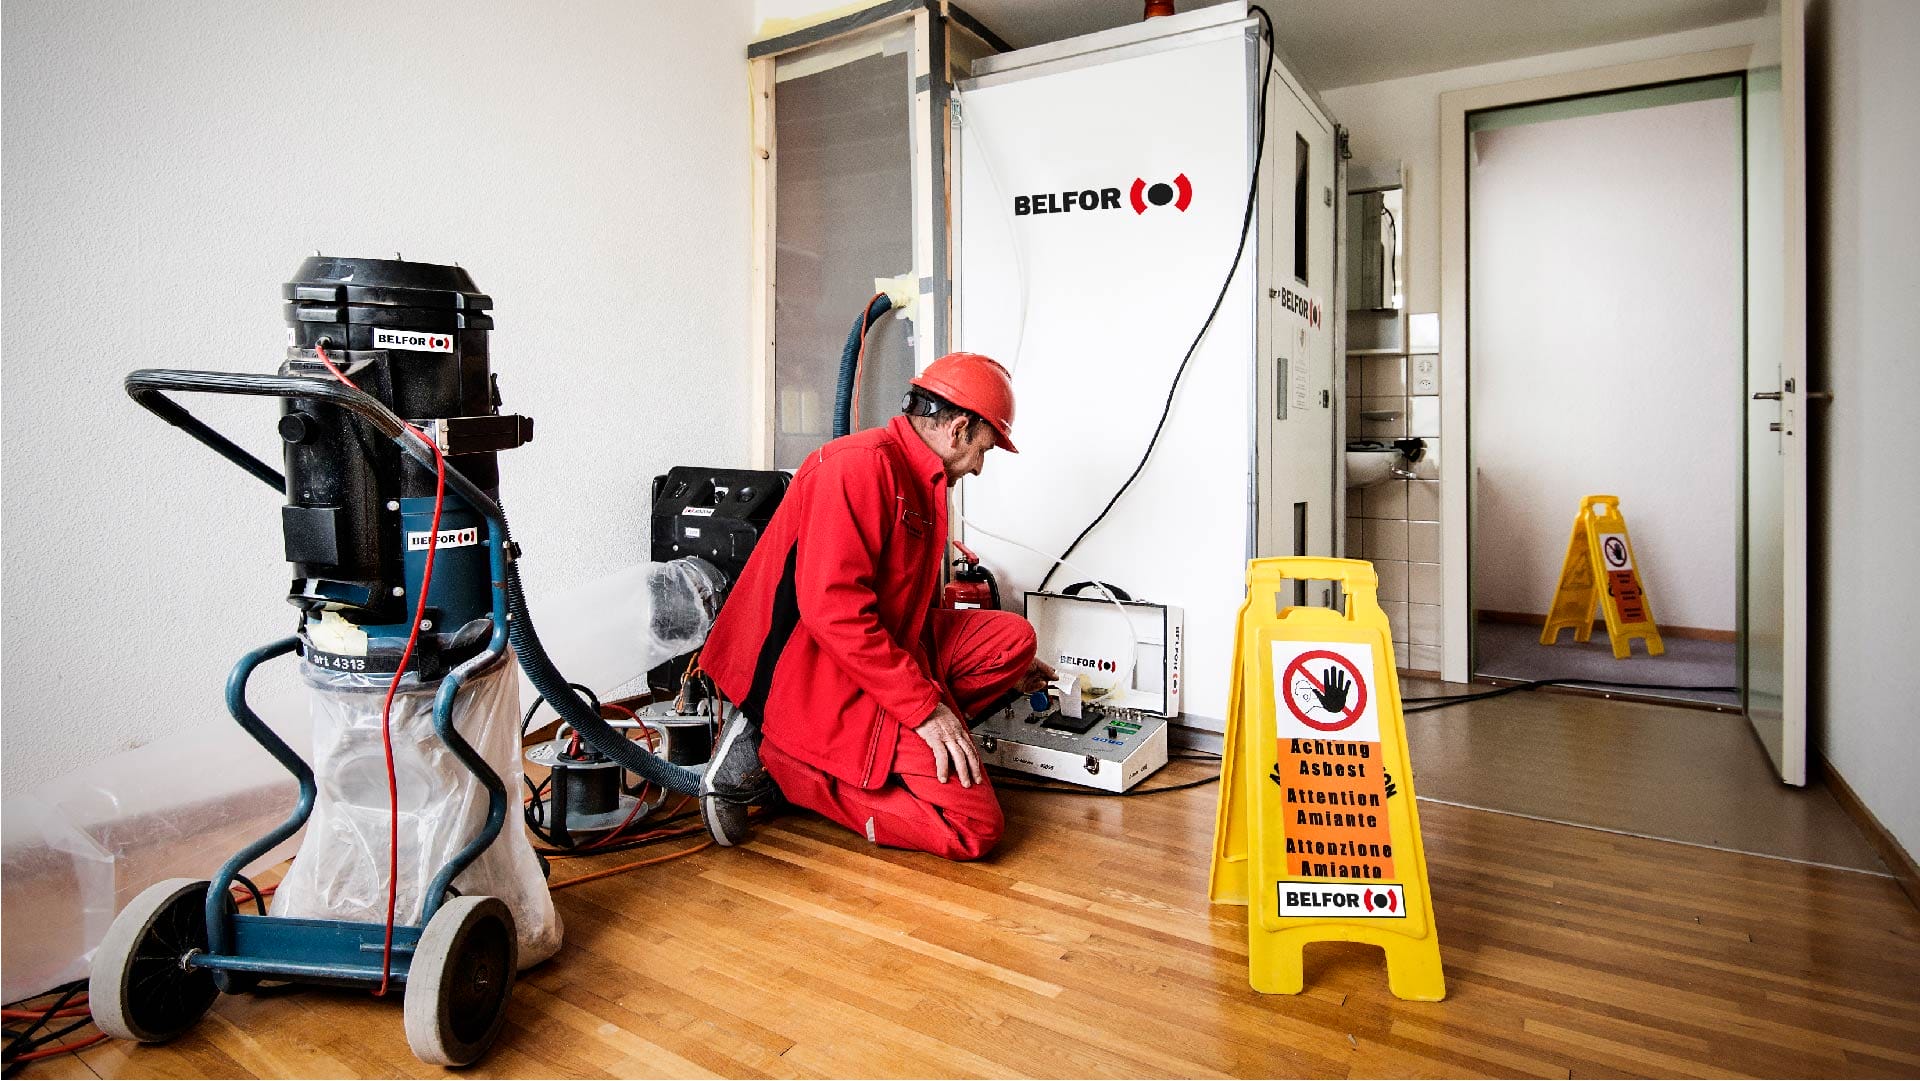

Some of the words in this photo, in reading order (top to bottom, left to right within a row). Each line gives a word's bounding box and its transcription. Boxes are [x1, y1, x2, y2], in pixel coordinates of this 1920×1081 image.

[1014, 187, 1122, 216] BELFOR
[1282, 287, 1309, 320] BELFOR
[378, 334, 426, 346] BELFOR
[313, 654, 330, 667] art
[333, 657, 366, 670] 4313
[1060, 655, 1096, 668] BELFOR
[1290, 738, 1370, 758] Achtung
[1300, 760, 1366, 777] Asbest
[1287, 787, 1380, 807] Attention
[1297, 809, 1377, 828] Amiante
[1286, 838, 1392, 858] Attenzione
[1301, 860, 1382, 879] Amianto
[1286, 891, 1360, 908] BELFOR
